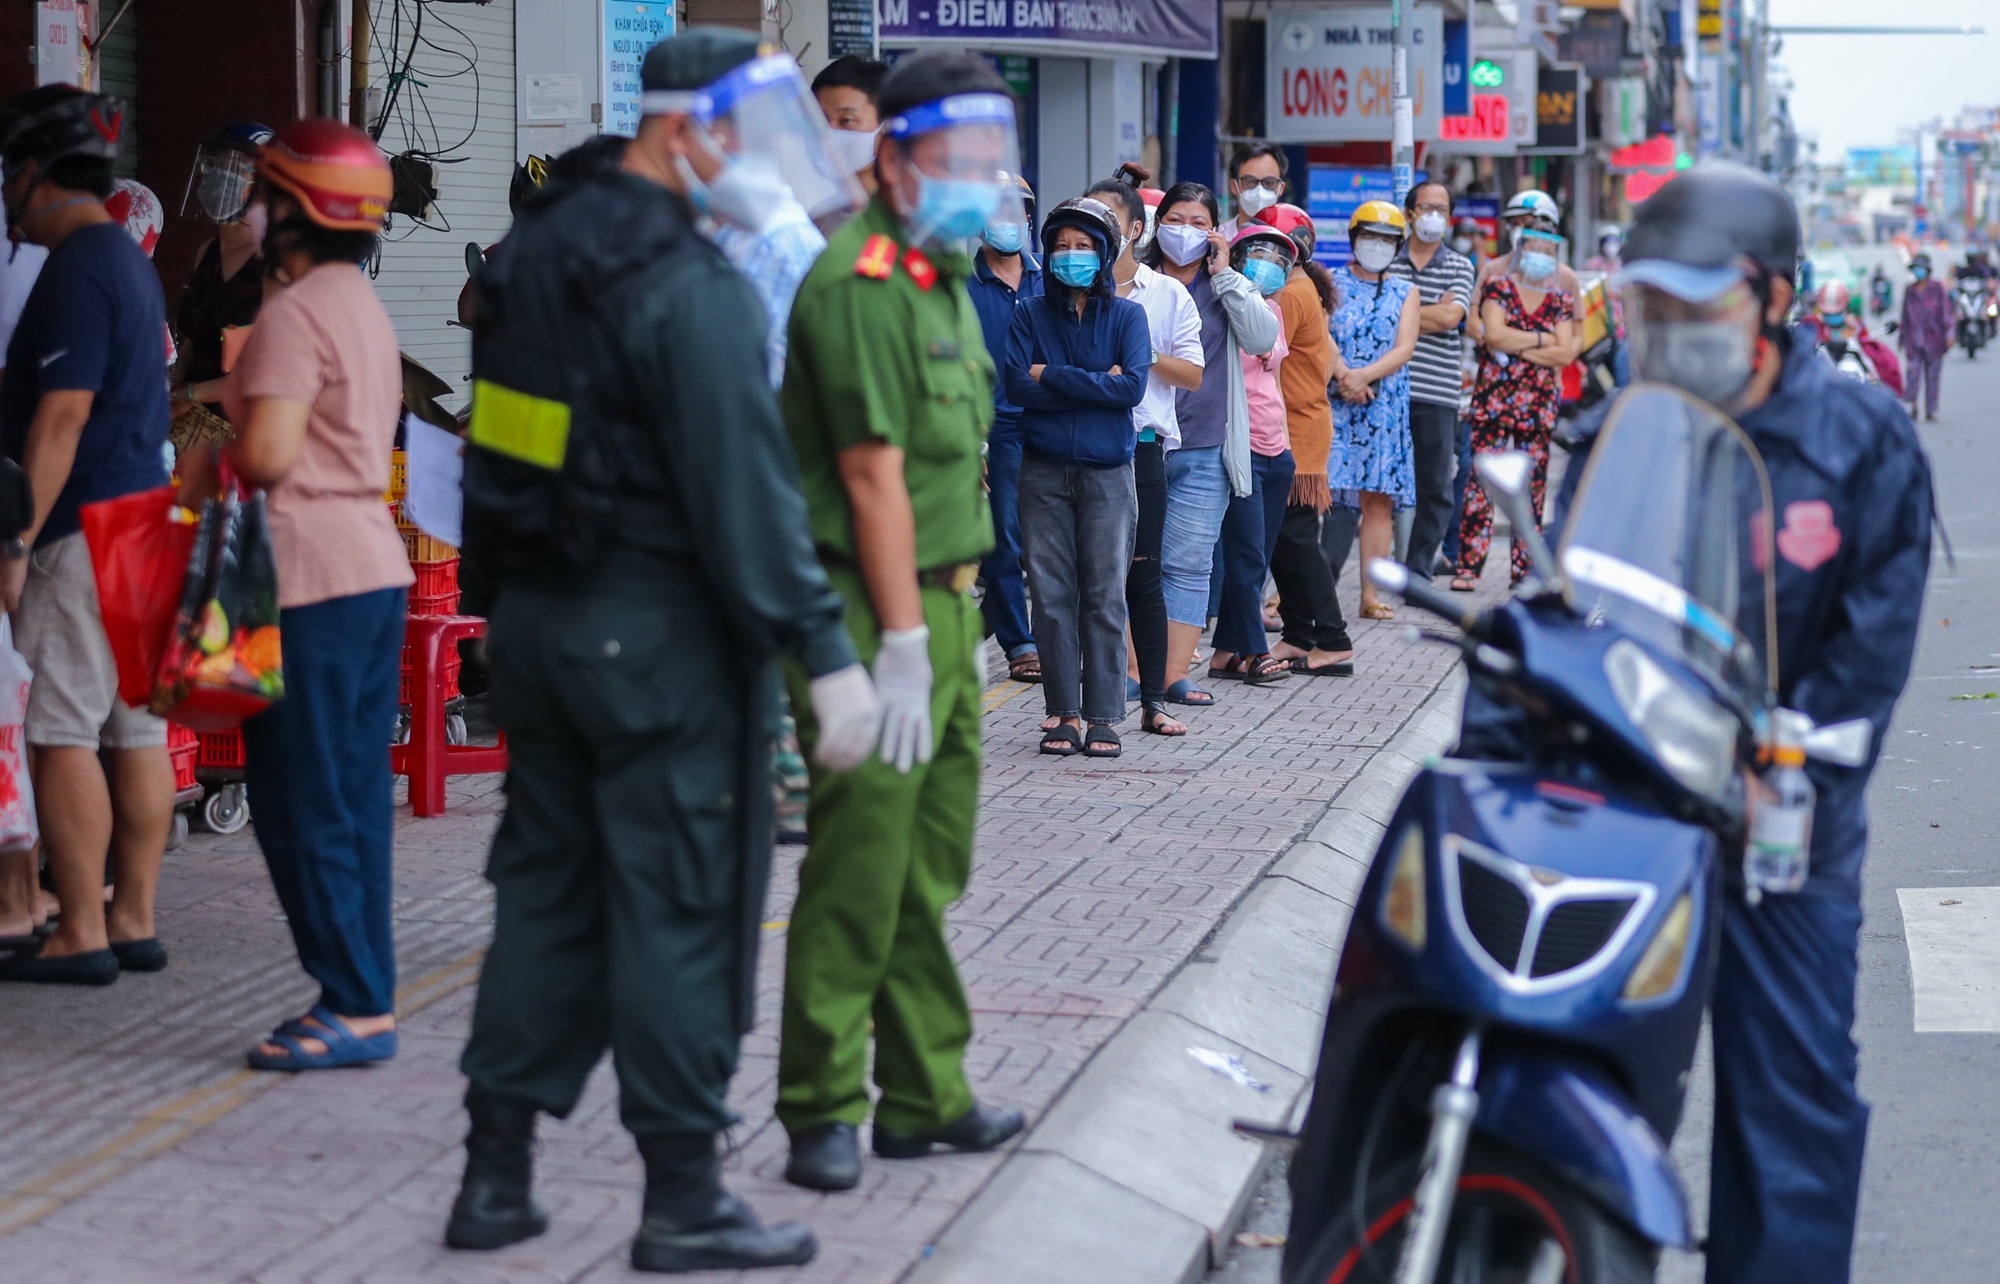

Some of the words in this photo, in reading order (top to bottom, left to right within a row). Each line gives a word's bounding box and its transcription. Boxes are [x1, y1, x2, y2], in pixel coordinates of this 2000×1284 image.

[1325, 25, 1361, 44] NHÀ
[1368, 27, 1424, 44] THC
[1283, 67, 1348, 118] LONG
[1356, 67, 1424, 118] CHU
